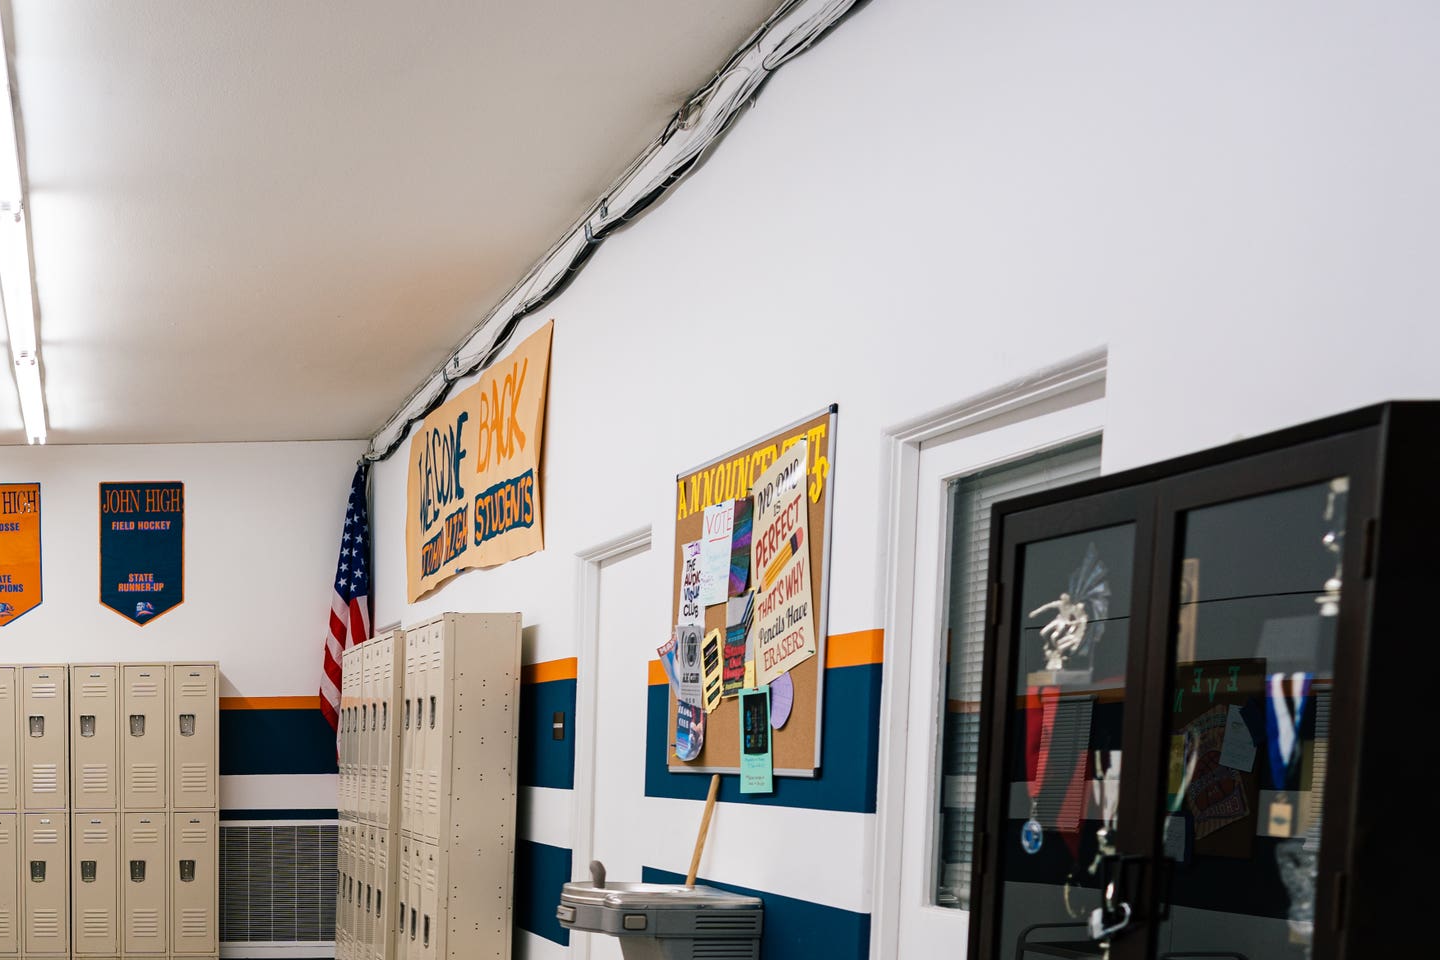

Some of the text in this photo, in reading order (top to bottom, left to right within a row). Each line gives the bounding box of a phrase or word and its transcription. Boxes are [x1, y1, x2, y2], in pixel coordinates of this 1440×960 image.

[476, 357, 528, 474] BACK
[2, 490, 38, 515] HIGH
[103, 488, 181, 514] JOHN HIGH
[444, 510, 468, 559] HIGH
[474, 475, 533, 542] STUDENTS
[757, 481, 774, 521] NO
[111, 520, 171, 531] FIELD HOCKEY
[705, 507, 734, 536] VOTE
[755, 493, 802, 580] PERFECT
[118, 582, 165, 592] RUNNER-UP
[128, 573, 154, 583] STATE
[757, 557, 805, 622] THAT'S WHY
[683, 603, 699, 619] CLUB
[758, 615, 785, 649] Pencils
[785, 601, 808, 629] Have
[763, 626, 805, 672] ERASERS
